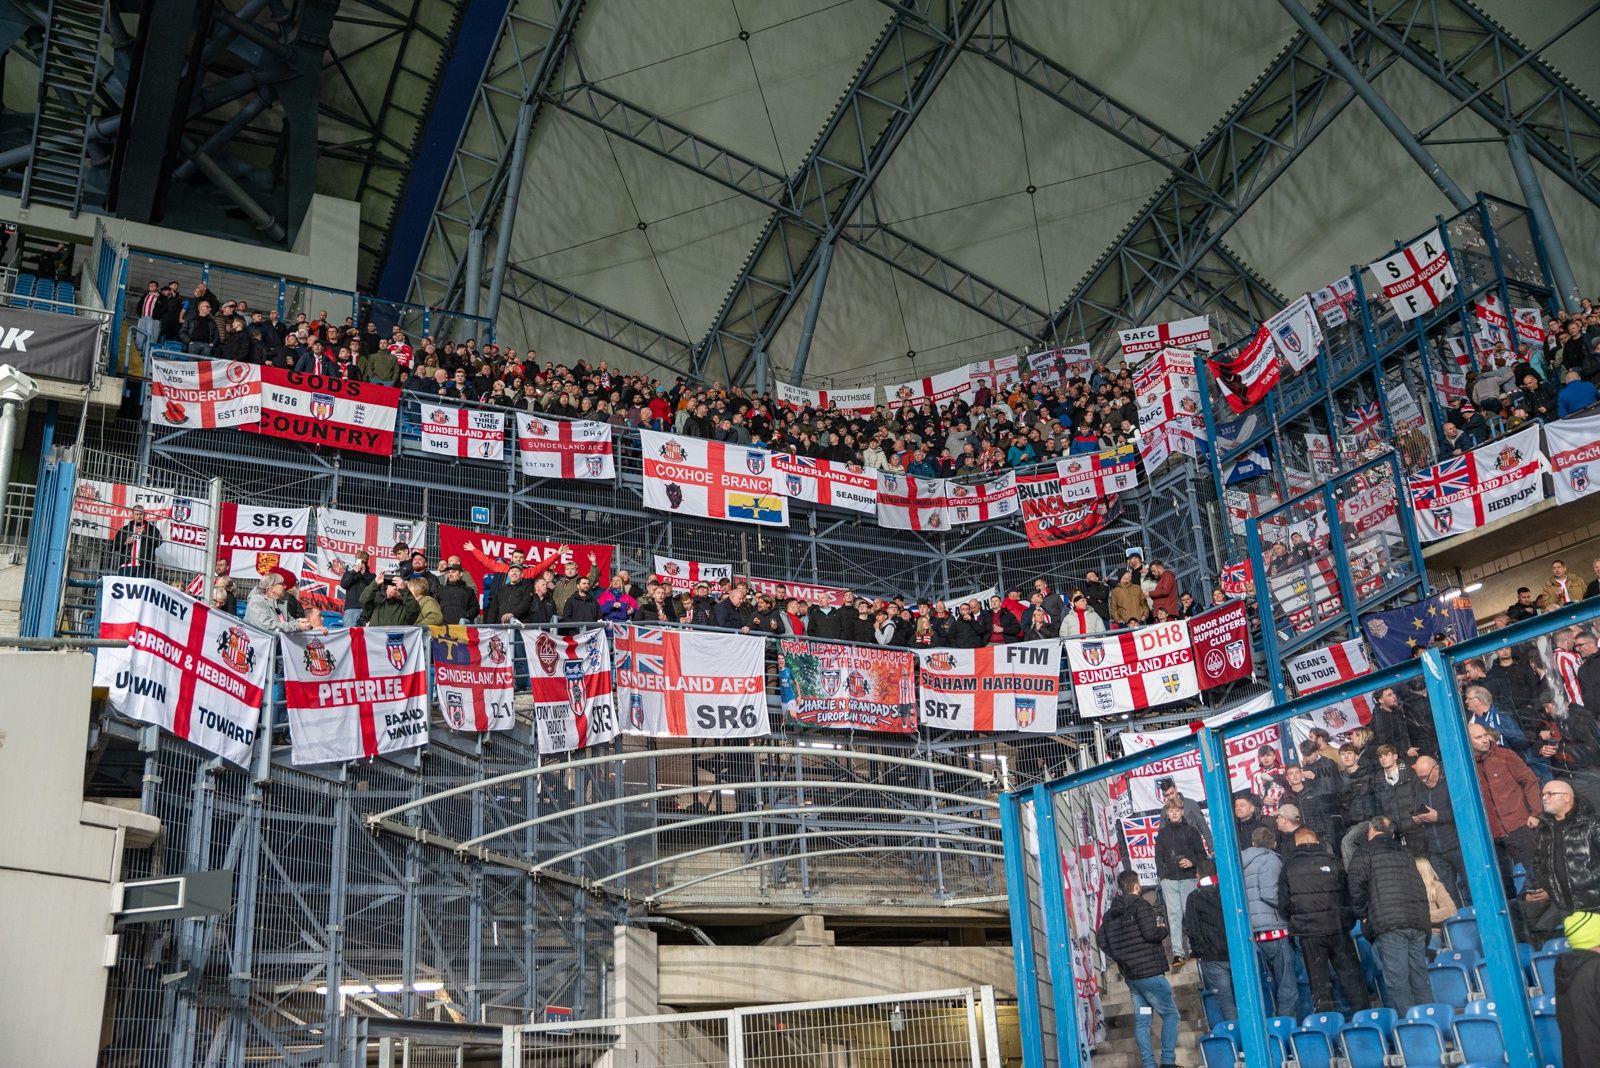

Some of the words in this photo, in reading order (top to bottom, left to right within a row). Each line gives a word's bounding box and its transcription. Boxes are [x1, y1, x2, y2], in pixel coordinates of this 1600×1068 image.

[1389, 278, 1416, 295] BISHOP
[1405, 295, 1417, 313] F
[0, 325, 35, 352] K
[1124, 330, 1155, 341] SAFC
[1125, 342, 1162, 353] CRADLE
[1177, 332, 1209, 344] GRAVE
[181, 369, 197, 377] THE
[1138, 366, 1175, 395] Sunderland
[163, 384, 251, 402] SUNDERLAND
[271, 392, 298, 407] NE36
[831, 393, 872, 402] SOUTHSIDE
[218, 410, 237, 420] EST
[239, 405, 260, 416] 1879
[473, 417, 500, 425] THREE
[1139, 406, 1163, 426] SAFC
[256, 412, 380, 448] COUNTRY
[423, 425, 483, 439] SUNDERLAND
[485, 431, 502, 441] AFC
[475, 422, 498, 430] TUNS
[430, 440, 449, 449] DH5
[528, 440, 586, 451] SUNDERLAND
[587, 444, 604, 452] AFC
[655, 464, 714, 484] COXHOE
[776, 460, 847, 483] SUNDERLAND
[849, 476, 871, 487] AFC
[1066, 470, 1113, 484] SUNDERLAND
[1115, 463, 1130, 474] AFC
[836, 490, 876, 506] SEABURN
[949, 497, 982, 506] STAFFORD
[983, 488, 1016, 503] MACKEMS
[1067, 486, 1091, 498] DL14
[1429, 479, 1500, 508] SUNDERLAND
[1501, 470, 1523, 485] AFC
[135, 493, 166, 504] FTM
[252, 513, 293, 528] SR6
[333, 519, 348, 527] THE
[1039, 517, 1056, 531] ON
[1058, 506, 1093, 526] TOUR
[325, 527, 356, 538] COUNTY
[269, 537, 304, 550] AFC
[319, 537, 363, 555] SOUTH
[481, 539, 517, 559] WE
[703, 567, 728, 578] FTM
[111, 582, 189, 621] SWINNEY
[1193, 619, 1218, 634] MOOR
[1218, 608, 1243, 624] NOOK
[1193, 617, 1248, 643] SUPPORTERS
[1140, 623, 1183, 651] DH8
[1210, 633, 1232, 647] CLUB
[781, 640, 810, 656] FROM
[811, 642, 849, 655] LEAGUE
[870, 649, 909, 663] EUROPE
[1006, 646, 1049, 665] FTM
[128, 628, 183, 664] JARROW
[184, 655, 193, 671] &
[196, 660, 247, 699] HEBBURN
[837, 657, 852, 668] THE
[854, 659, 872, 671] END
[1078, 656, 1162, 684] SUNDERLAND
[1165, 650, 1190, 666] AFC
[1294, 655, 1328, 671] KEAN'S
[720, 677, 757, 693] AFC
[982, 677, 1054, 692] HARBOUR
[1296, 674, 1311, 685] ON
[1312, 667, 1336, 680] TOUR
[318, 678, 406, 707] PETERLEE
[696, 704, 758, 730] SR6
[796, 699, 837, 713] CHARLIE
[839, 700, 846, 709] N
[849, 700, 900, 718] GRANDAD'S
[925, 699, 961, 720] SR7
[591, 704, 612, 734] SR3
[859, 713, 878, 725] TOUR
[1131, 754, 1203, 777] MACKEMS
[1236, 727, 1279, 753] TOUR
[1132, 846, 1156, 858] SUN
